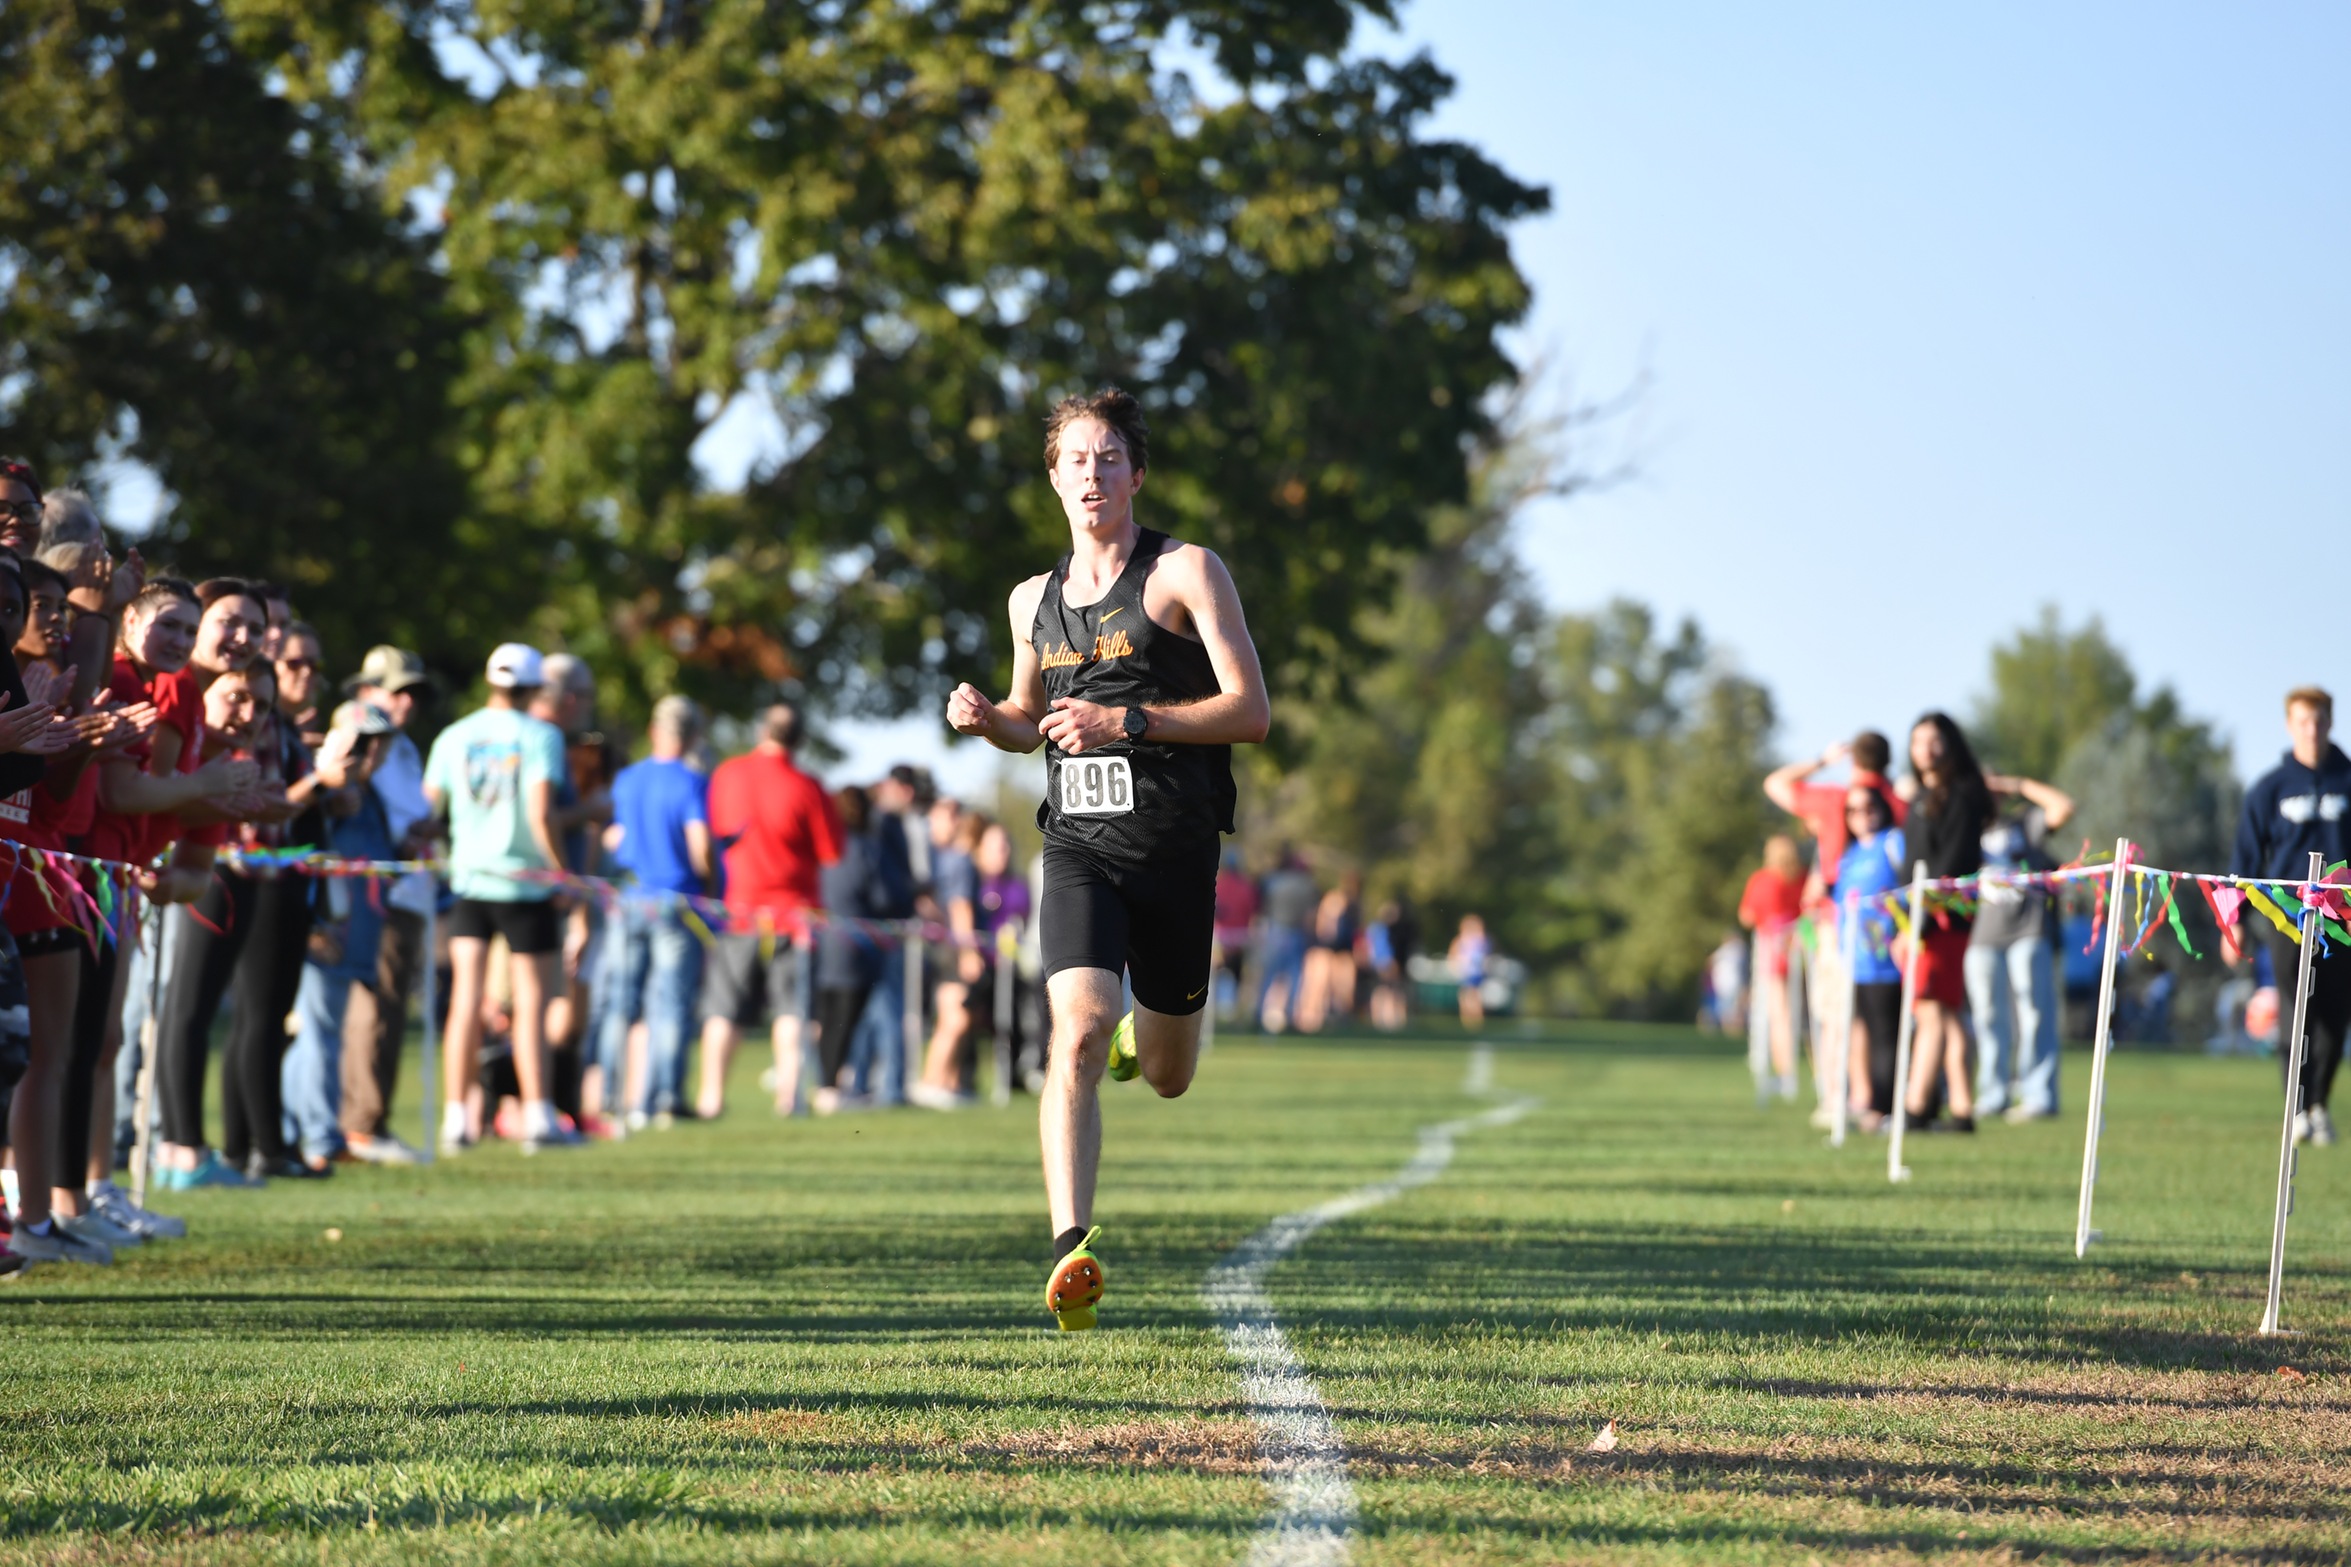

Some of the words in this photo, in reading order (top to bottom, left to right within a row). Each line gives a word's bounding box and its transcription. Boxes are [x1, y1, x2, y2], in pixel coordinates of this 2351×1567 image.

[1041, 641, 1085, 671] Indian
[1091, 629, 1134, 662] Hills
[1065, 762, 1127, 808] 896
